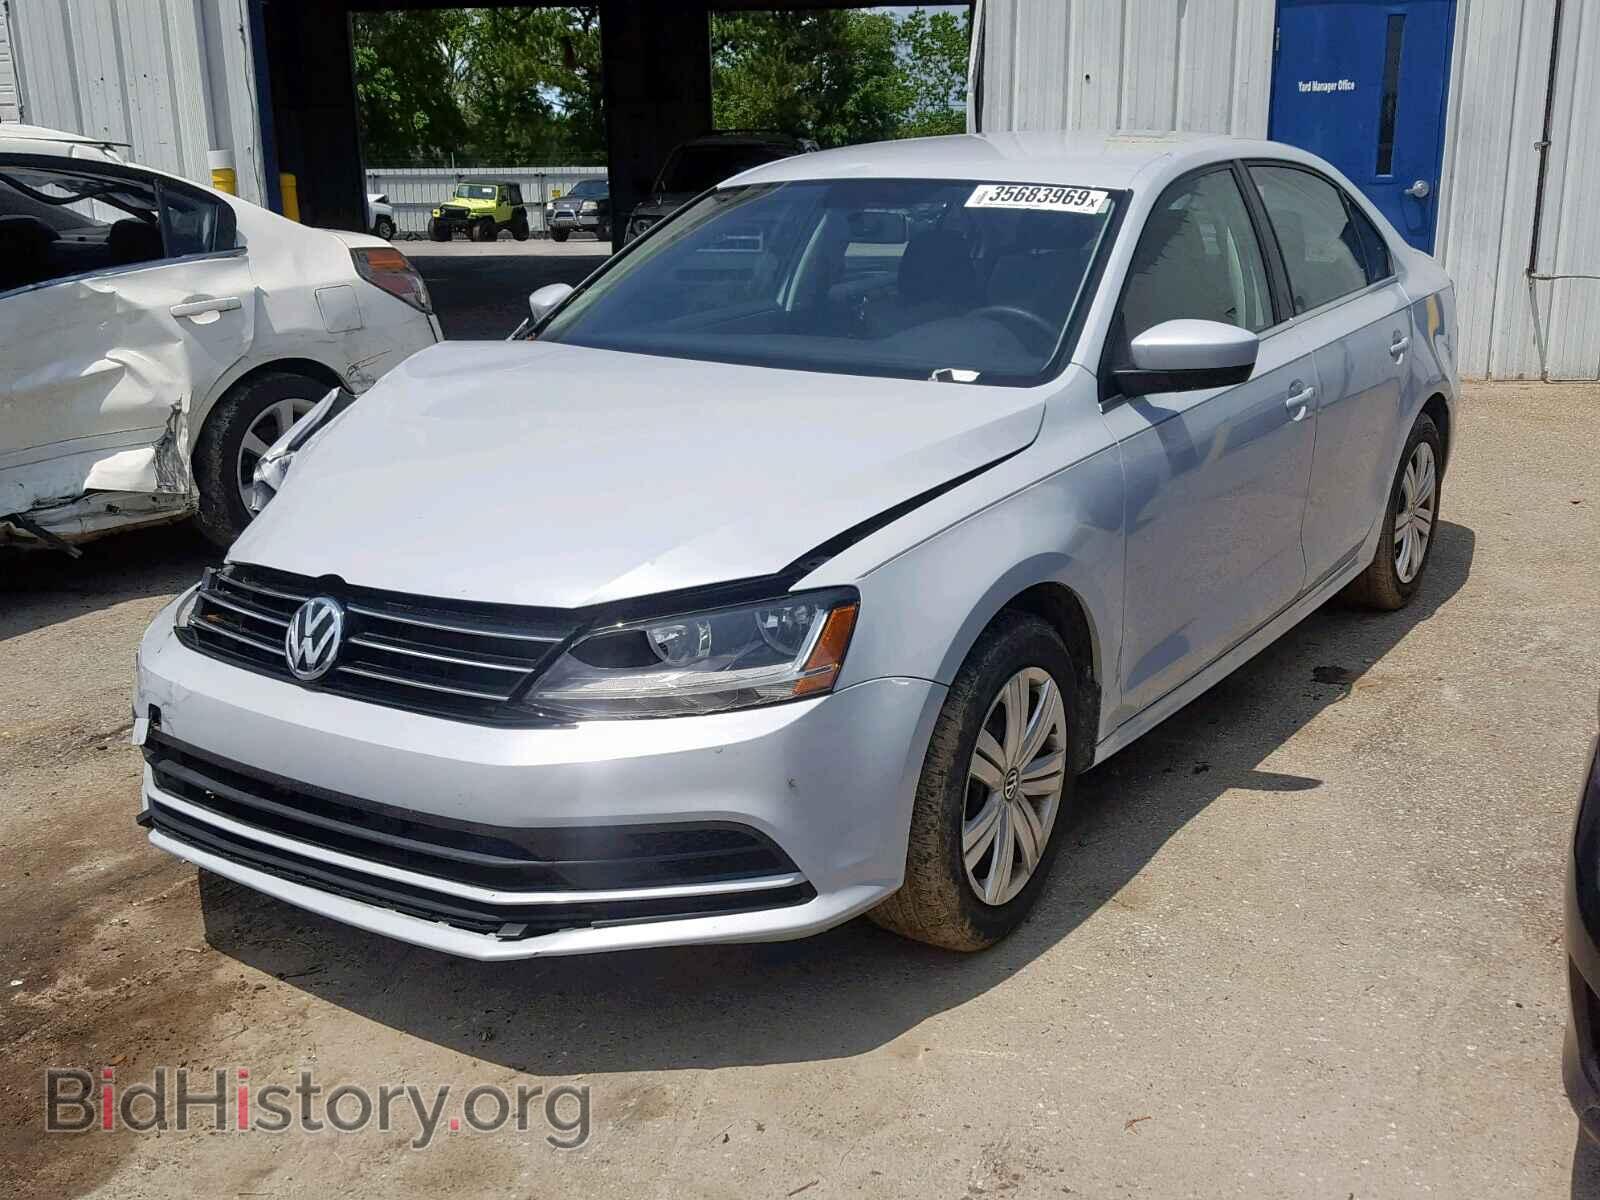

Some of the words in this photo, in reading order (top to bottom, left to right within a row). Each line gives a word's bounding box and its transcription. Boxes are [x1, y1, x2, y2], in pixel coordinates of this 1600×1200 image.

[1298, 81, 1311, 92] Yard
[1312, 80, 1337, 93] Manager
[1338, 80, 1355, 91] Office
[989, 186, 1091, 206] 35683969
